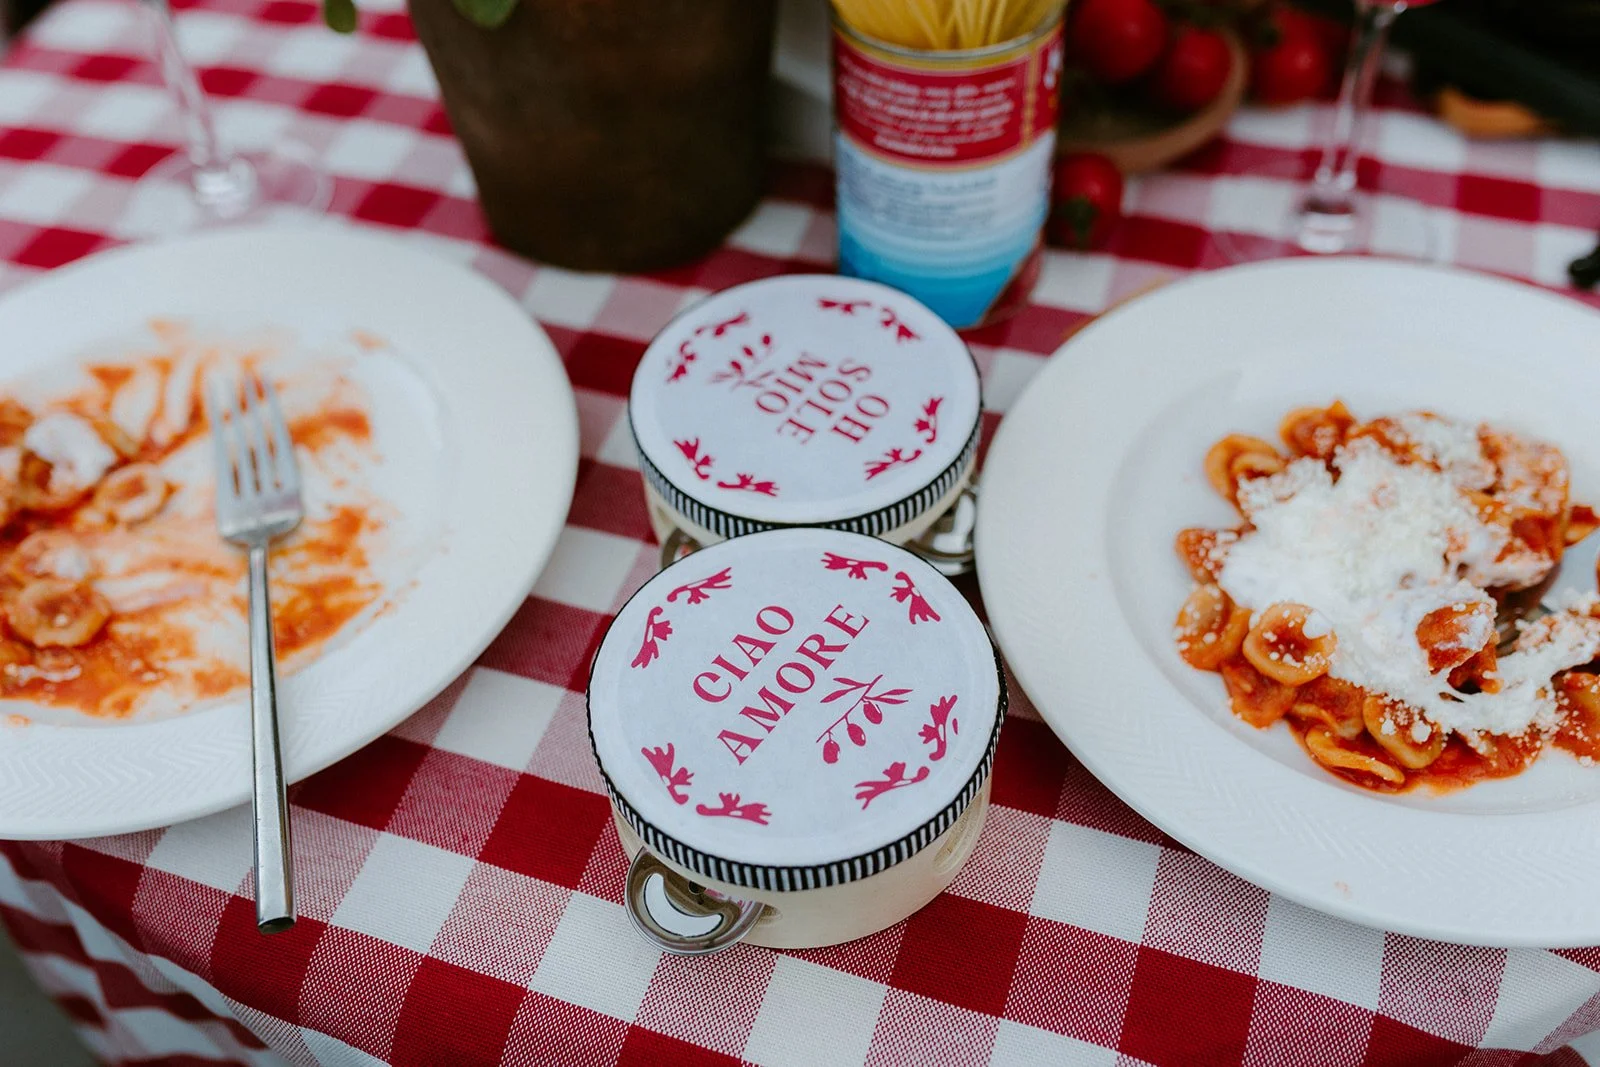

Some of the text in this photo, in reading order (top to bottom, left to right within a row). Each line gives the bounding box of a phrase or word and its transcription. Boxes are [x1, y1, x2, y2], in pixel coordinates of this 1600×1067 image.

[755, 352, 829, 414] MIO
[776, 358, 873, 445] SOLE
[831, 395, 890, 443] OH
[693, 605, 794, 703] CIAO
[716, 603, 870, 766] AMORE
